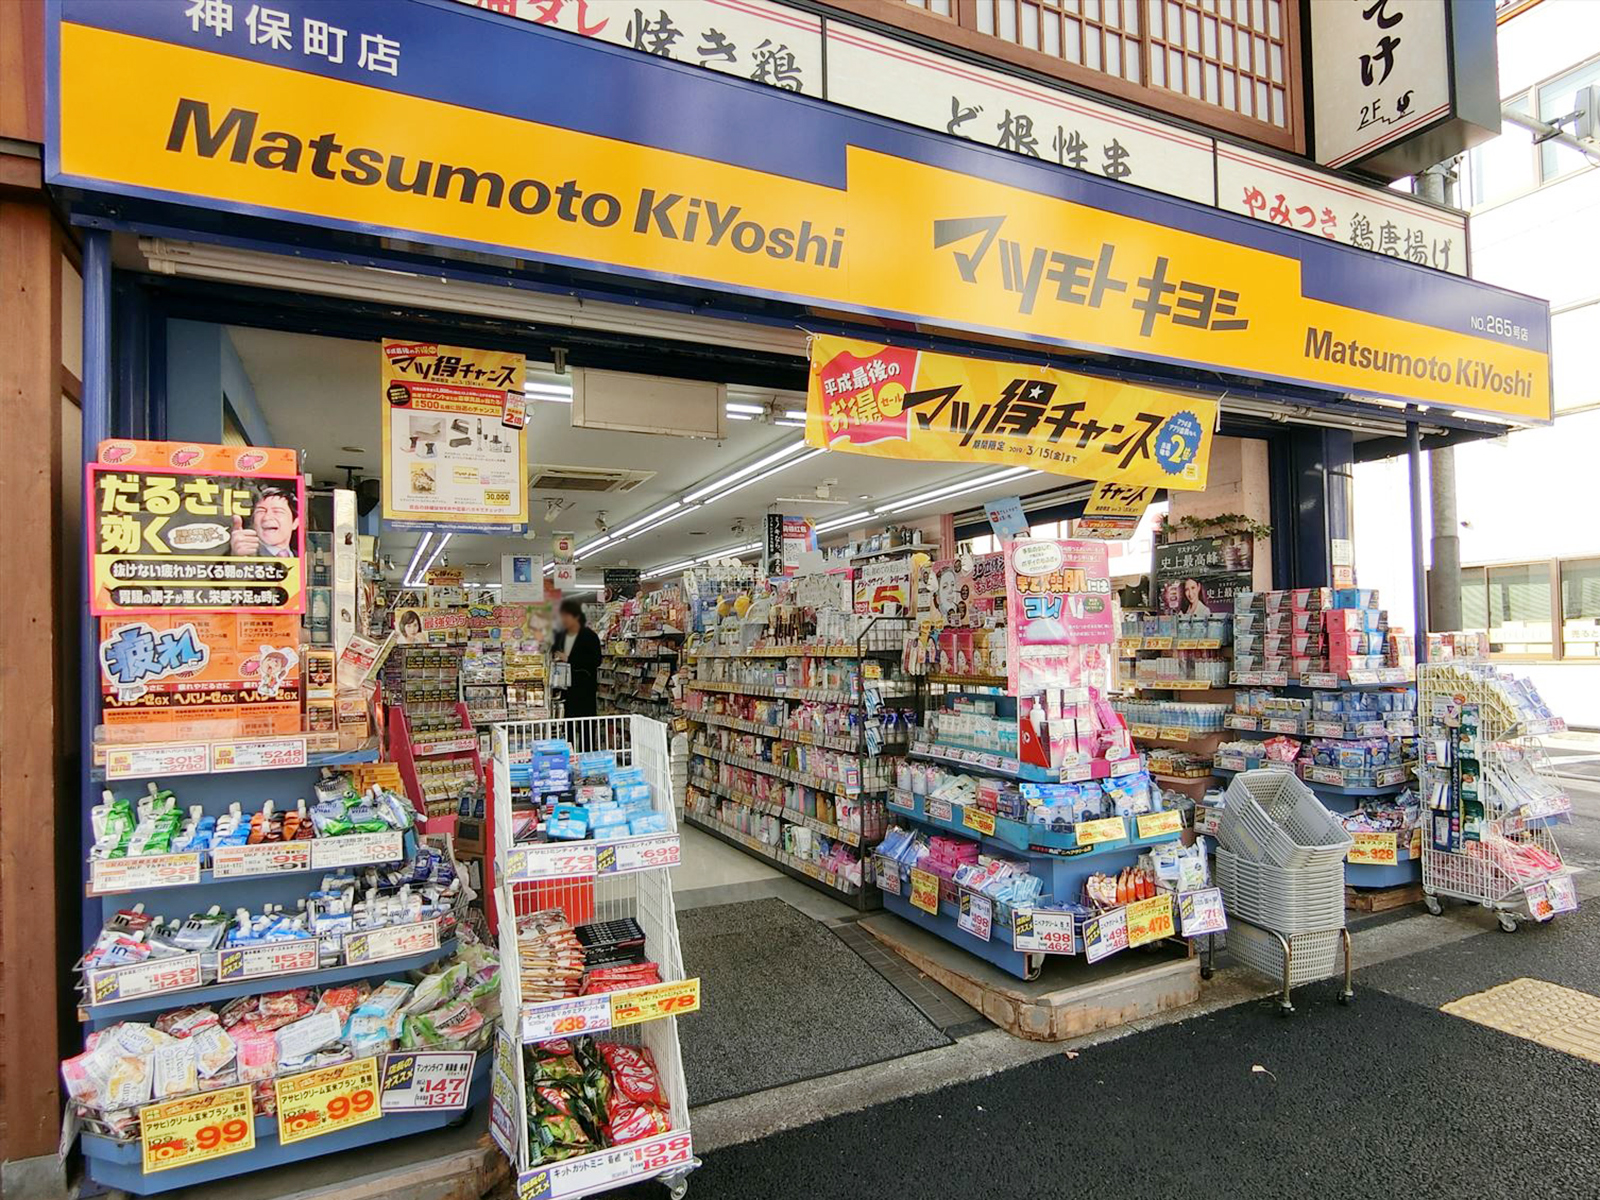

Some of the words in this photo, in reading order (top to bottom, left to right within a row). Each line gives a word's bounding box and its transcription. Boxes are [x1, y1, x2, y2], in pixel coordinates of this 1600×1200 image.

[185, 0, 401, 76] 神保町店
[1360, 99, 1381, 124] 2F
[166, 97, 621, 228] Matsumoto
[633, 188, 845, 269] KiYoshi
[1242, 186, 1337, 239] やみつき
[933, 215, 1249, 337] マツモトキヨシ
[391, 355, 517, 387] マツ得チャンス
[1305, 327, 1451, 383] Matsumoto
[1456, 357, 1531, 398] KiYoshi
[824, 359, 901, 397] 平成最後の
[881, 393, 903, 408] セール
[902, 378, 1166, 469] マツ得チャンス
[972, 440, 1006, 451] 期間限定
[100, 474, 251, 516] だるさに
[100, 514, 172, 554] 効く
[1177, 544, 1203, 555] リステリン
[1161, 551, 1218, 570] 史上最高峰
[113, 560, 284, 580] 抜けない疲れからくる朝のだるさに
[119, 588, 281, 605] 胃腸の調子が悪く、栄養不足な時に
[1024, 596, 1062, 619] コレ!
[173, 691, 235, 706] ヘパリーゼGX
[164, 754, 204, 765] 3013
[264, 750, 301, 758] 5248
[273, 854, 308, 864] 98
[560, 855, 595, 866] 79
[643, 846, 680, 858] 699
[159, 867, 197, 876] 98
[567, 864, 593, 873] 74
[114, 915, 131, 926] in
[186, 920, 203, 930] in
[972, 912, 989, 927] 198
[1148, 914, 1171, 934] 478
[1044, 932, 1071, 943] 498
[1108, 926, 1128, 940] 498
[112, 945, 128, 956] in
[274, 950, 315, 962] 159
[1047, 942, 1070, 952] 462
[221, 961, 242, 977] オススメ
[279, 959, 313, 970] 148
[153, 967, 197, 983] 159
[658, 994, 696, 1012] 78
[553, 1014, 587, 1034] 238
[388, 1057, 414, 1075] 店長の
[384, 1068, 414, 1089] オススメ
[425, 1078, 465, 1093] 147
[281, 1079, 356, 1104] アサヒ)クリーム玄米ブラン
[428, 1092, 460, 1106] 137
[326, 1089, 375, 1120] 99
[146, 1107, 229, 1132] アサヒ)クリーム玄米ブラン
[195, 1118, 248, 1150] 99
[633, 1136, 690, 1162] 198
[553, 1157, 605, 1178] キットカットミニ
[643, 1149, 689, 1171] 184
